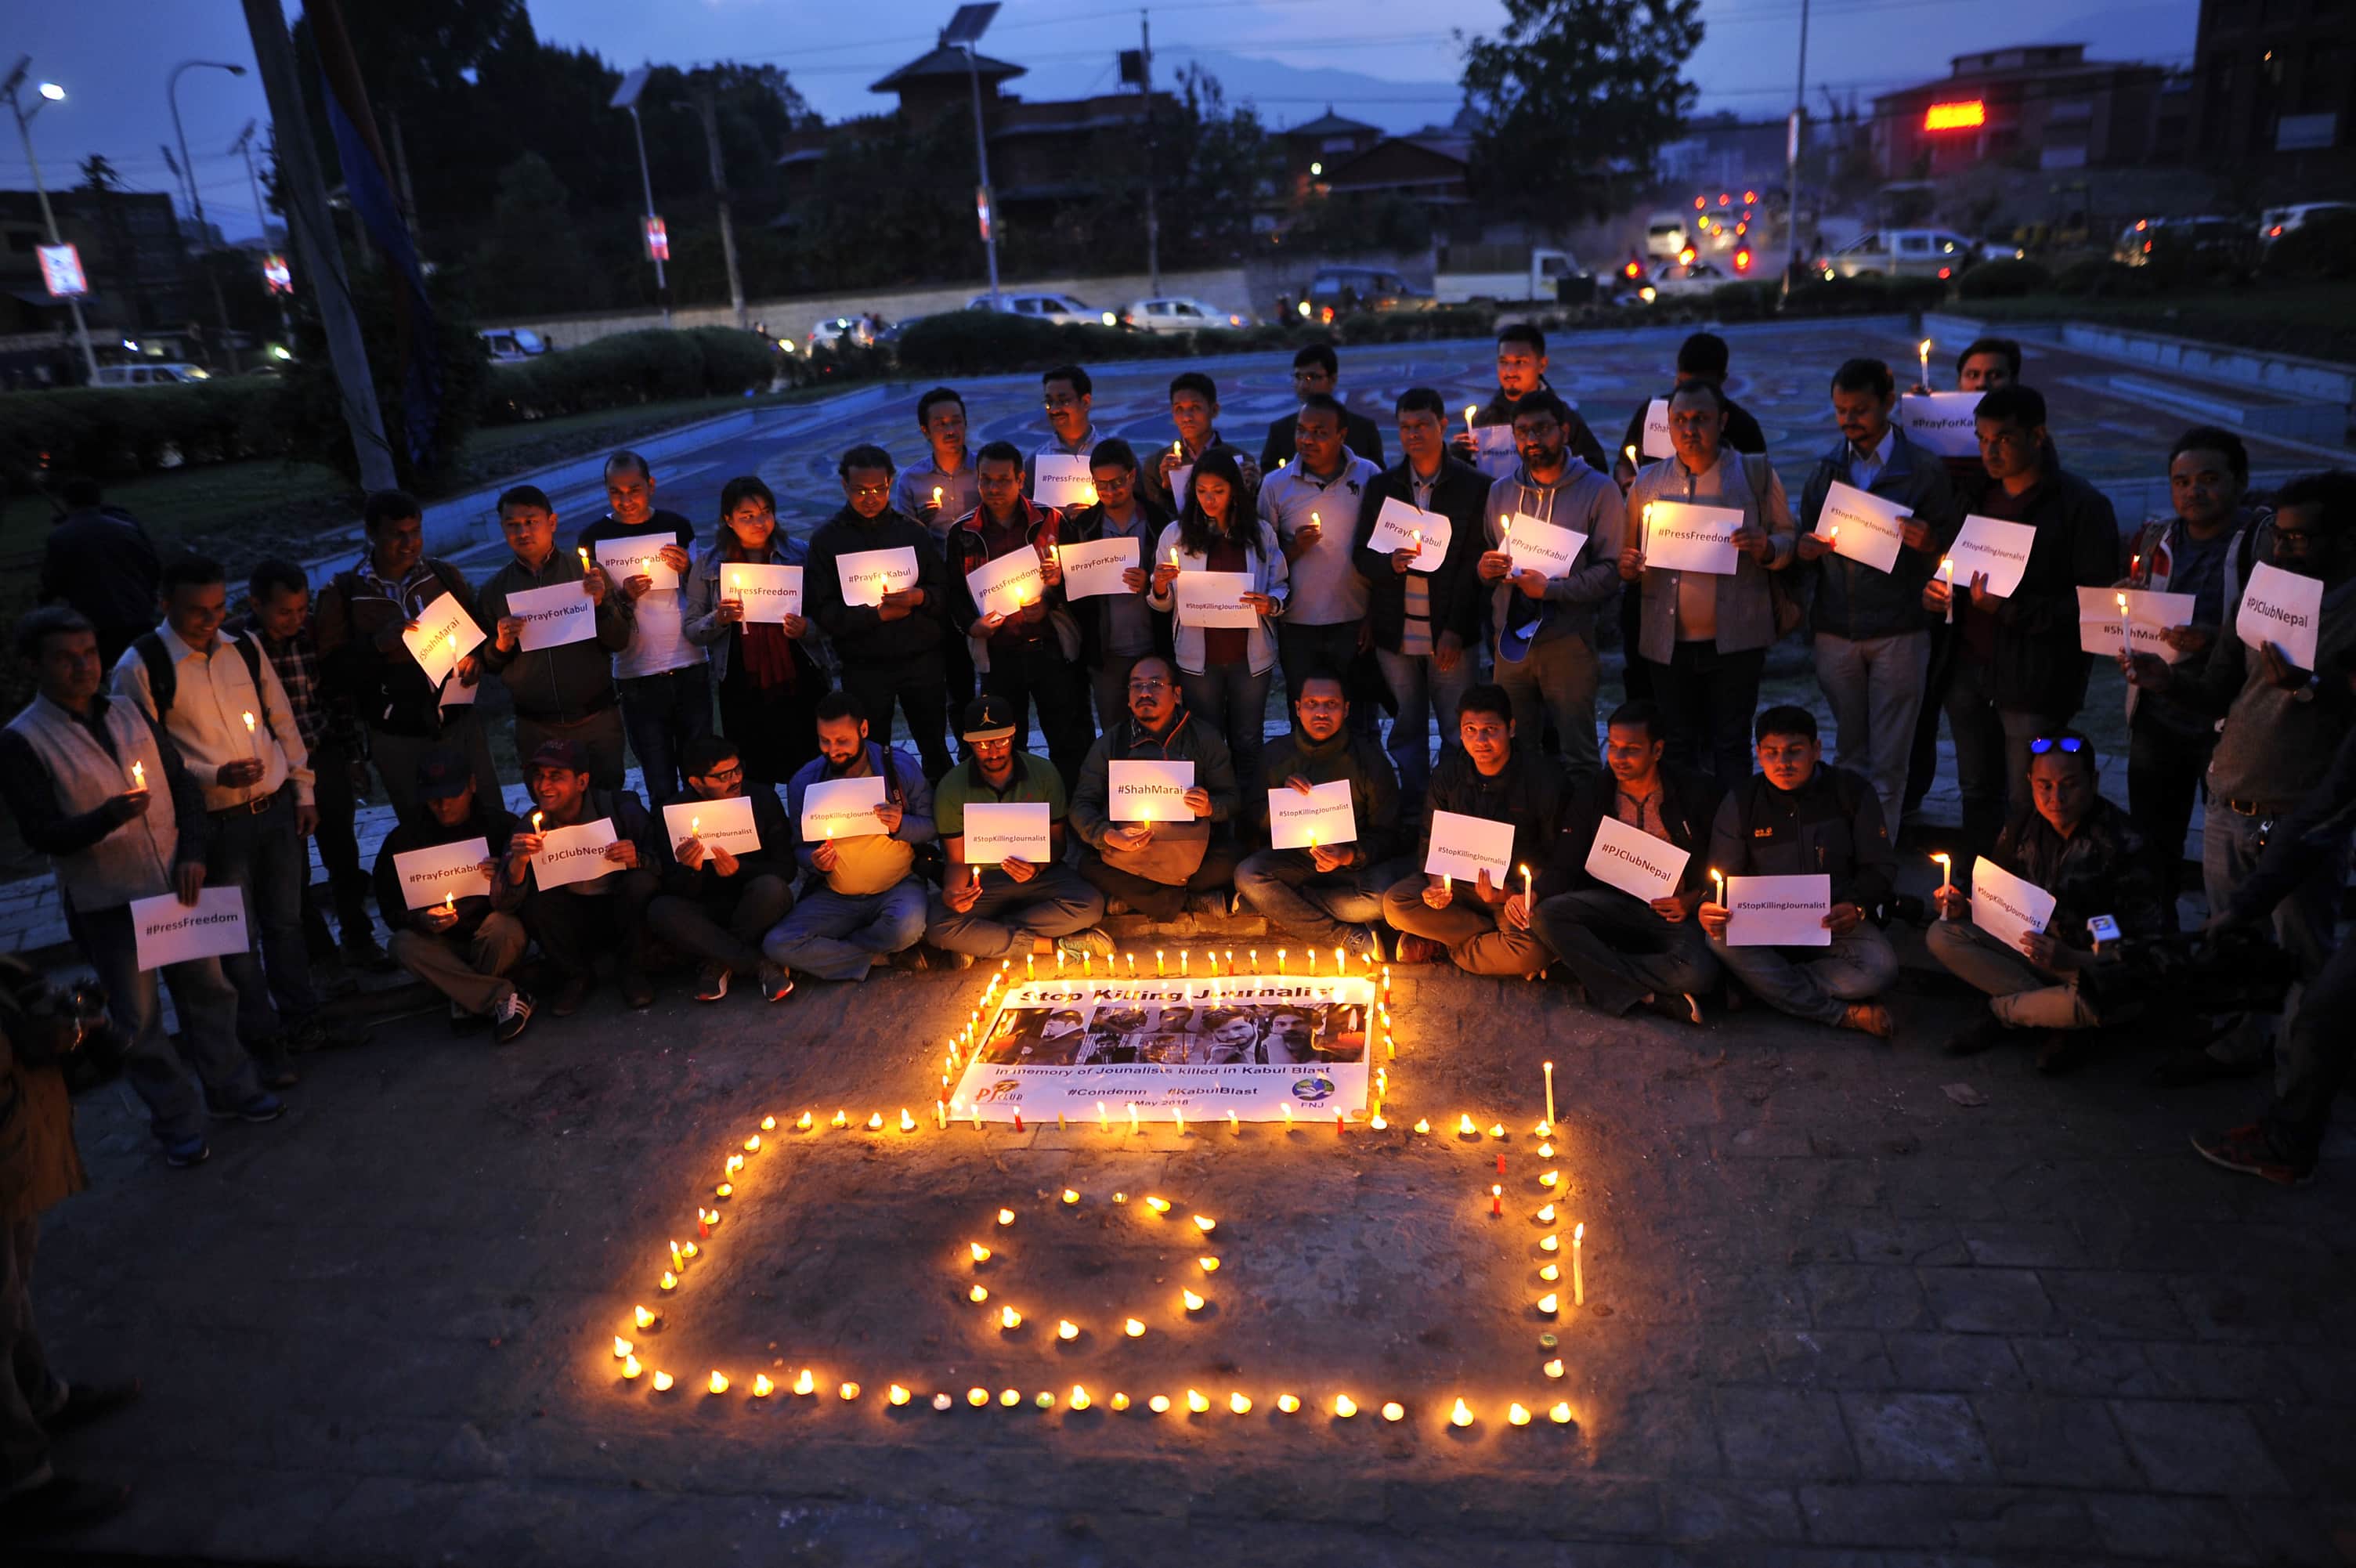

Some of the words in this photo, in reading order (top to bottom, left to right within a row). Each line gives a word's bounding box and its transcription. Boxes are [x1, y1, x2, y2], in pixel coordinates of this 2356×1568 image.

[1913, 417, 1976, 430] #PrayForKa
[1042, 474, 1091, 483] #PressFreed
[1830, 508, 1899, 540] #StopKillingJournalist
[1384, 521, 1443, 548] #PrayFKabul
[1511, 537, 1568, 562] #PrayForKabul
[1961, 540, 2025, 562] #StopKillingJournalist
[605, 554, 667, 567] #PrayForabu
[1070, 554, 1127, 573] #PrayForKabul
[978, 566, 1039, 599] #PressFreedom
[524, 603, 588, 622] PrayForKabul
[1186, 602, 1252, 611] #StopKillingJournalist
[2246, 597, 2308, 629] #PJClubNepal
[418, 616, 461, 662] #ShahMarai
[2104, 624, 2166, 642] #ShhMar
[1118, 783, 1183, 795] #ShahMarai
[810, 810, 876, 822] #StopKillingJournal
[1279, 803, 1350, 818] #StopKillingJournalist
[678, 828, 753, 842] #StKillingJournalist
[973, 834, 1046, 844] #StopKillingJournalist
[541, 847, 612, 865] PJClubNepa
[1438, 845, 1507, 867] #StopKillingJournalist
[1602, 842, 1672, 882] #PJClubNepal
[410, 864, 480, 883] #PrayForKabu
[1737, 901, 1827, 911] #StopKillingJournalist
[1977, 886, 2042, 929] #StopKillingJournalist
[146, 912, 238, 936] #PressFreedom
[1020, 991, 1083, 1003] Stop
[1093, 988, 1183, 1002] Killing
[1193, 987, 1335, 999] Jurnalis
[1012, 1068, 1073, 1078] memory
[1178, 1067, 1219, 1075] killed
[1167, 1086, 1259, 1096] #KabulBlast
